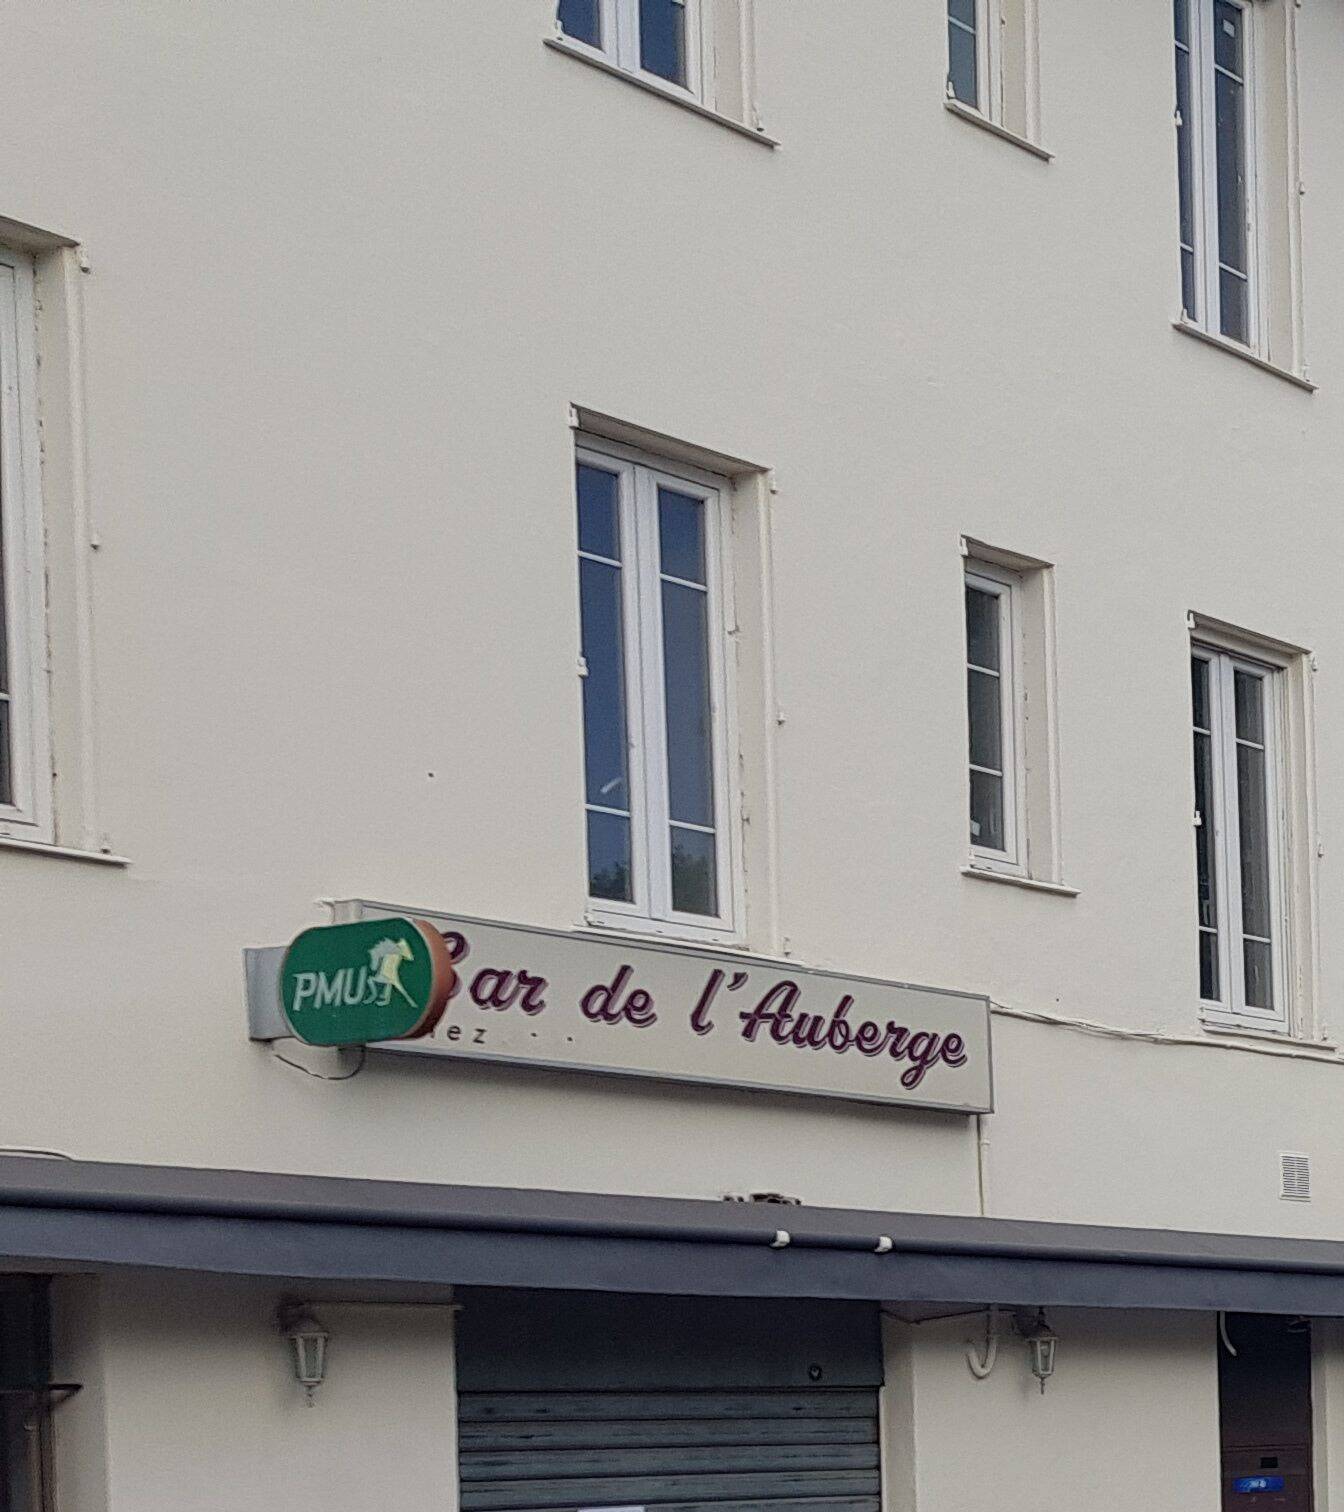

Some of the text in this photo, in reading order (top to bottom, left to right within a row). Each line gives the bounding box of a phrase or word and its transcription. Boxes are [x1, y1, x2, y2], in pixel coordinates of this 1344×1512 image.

[291, 967, 368, 1012] PMU
[579, 963, 658, 1028] de
[690, 969, 968, 1090] l'Auberge
